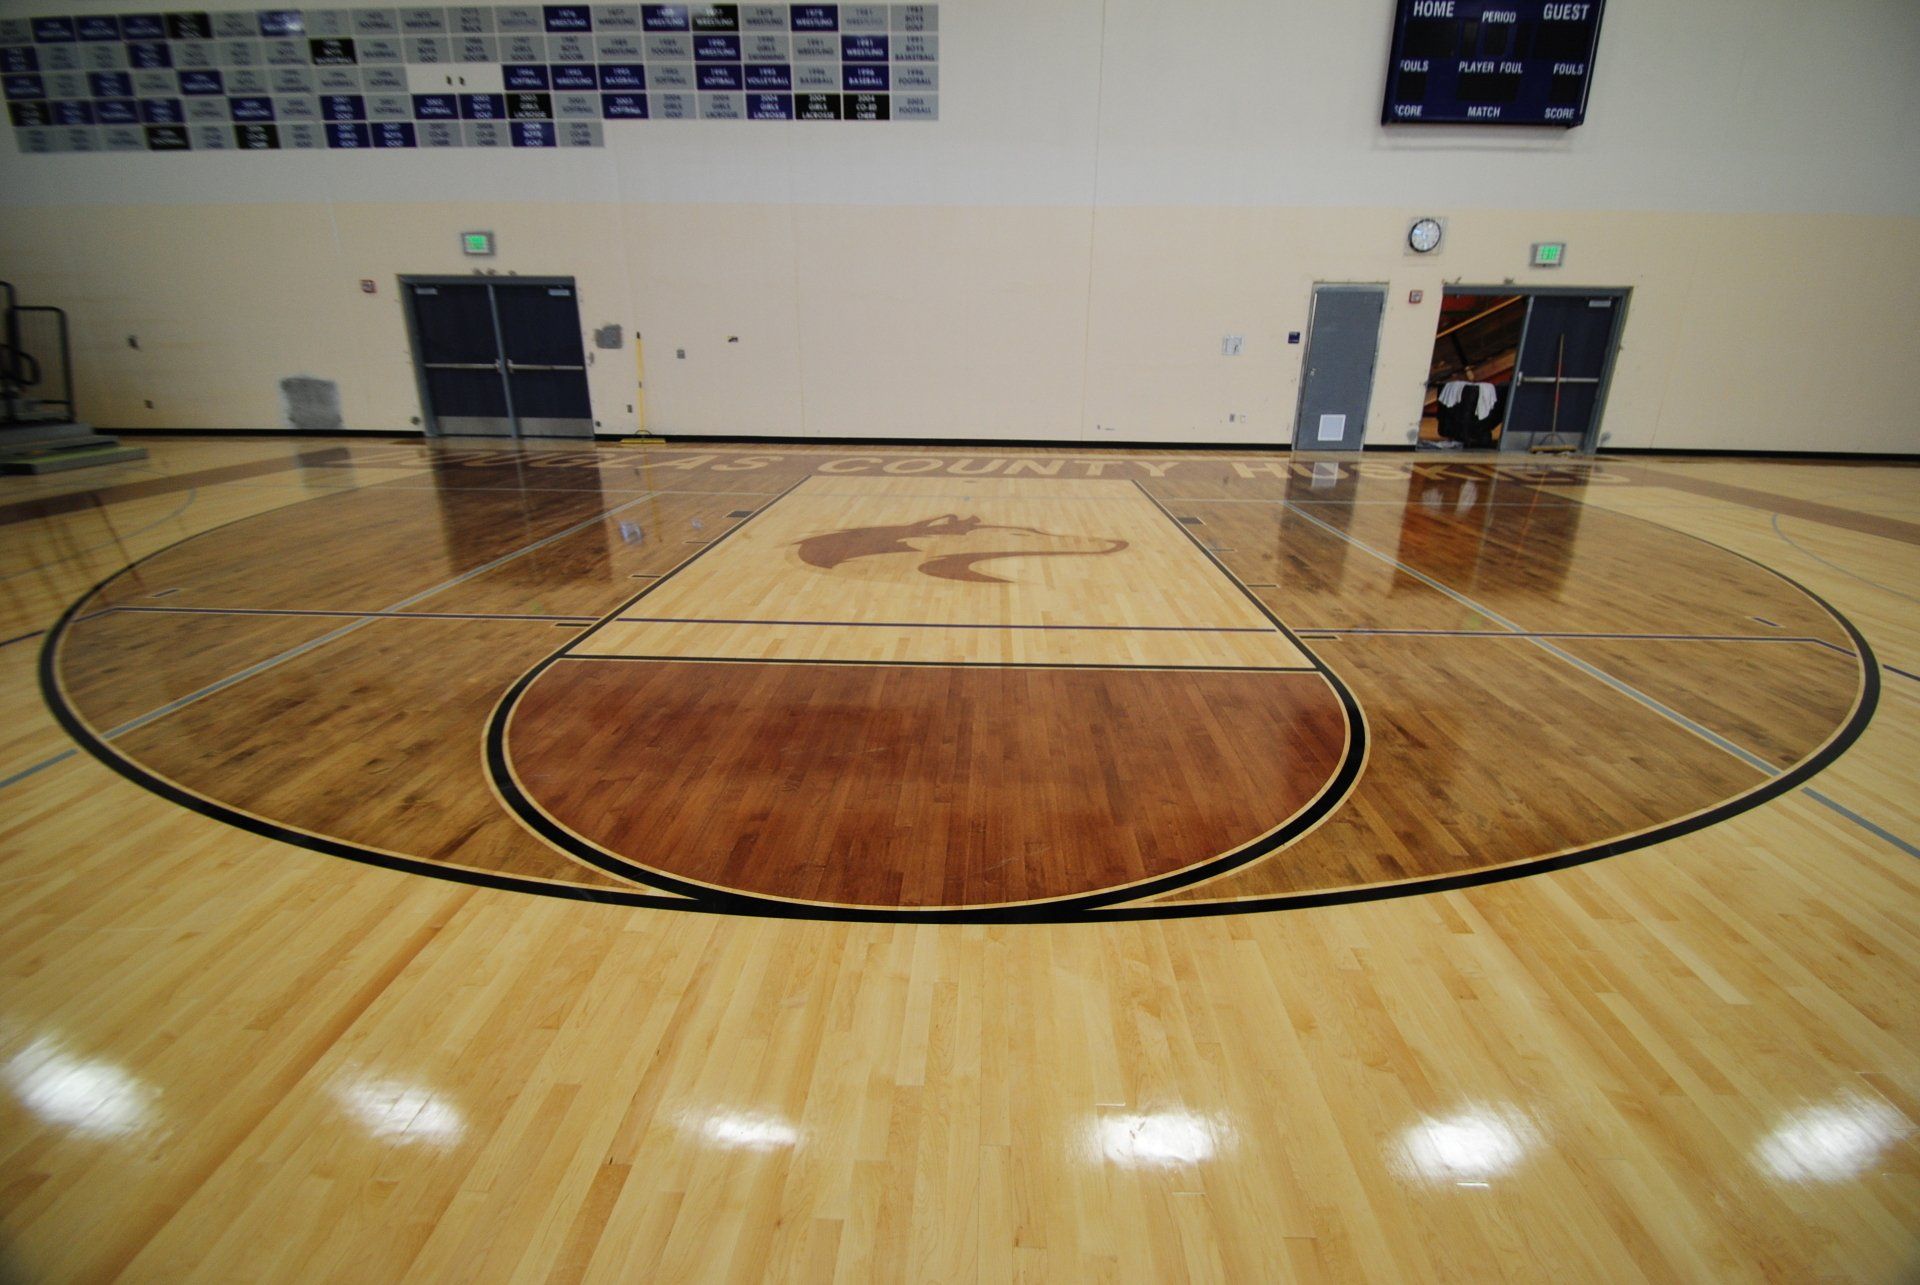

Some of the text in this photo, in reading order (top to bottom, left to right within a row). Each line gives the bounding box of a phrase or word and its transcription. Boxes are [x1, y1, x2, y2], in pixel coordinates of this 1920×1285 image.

[1413, 1, 1454, 17] HOME
[1543, 4, 1590, 20] GUEST
[747, 17, 783, 25] WRESTLING
[846, 17, 883, 25] WRESTLING
[1482, 11, 1516, 23] PERIOD
[549, 19, 586, 27] WRESTLING
[646, 18, 685, 26] WRESTLING
[696, 18, 734, 26] WRESTLING
[795, 18, 834, 26] WRESTLING
[601, 47, 638, 55] WRESTLING
[698, 48, 736, 57] WRESTLING
[797, 47, 834, 55] WRESTLING
[846, 48, 884, 57] WRESTLING
[895, 54, 935, 62] BASKETBALL
[1458, 61, 1523, 73] PLAYER FOUL
[1553, 63, 1584, 75] FOULS
[556, 77, 593, 85] WRESTLING
[605, 77, 640, 85] BASEBALL
[704, 77, 736, 86] SOFTBALL
[747, 77, 789, 85] VOLLEYBALL
[799, 77, 834, 85] BASEBALL
[848, 77, 883, 86] BASEBALL
[898, 77, 932, 85] FOOTBALL
[760, 102, 779, 111] GIRLS
[808, 103, 827, 111] GIRLS
[856, 103, 877, 111] CO-ED
[899, 106, 931, 114] FOOTBALL
[705, 111, 738, 119] LACROSSE
[753, 111, 787, 119] LACROSSE
[802, 111, 835, 120] LACROSSE
[1467, 106, 1501, 117] MATCH
[1544, 108, 1575, 119] SCORE
[856, 112, 876, 120] CHEER
[817, 457, 1180, 477] COUNTY
